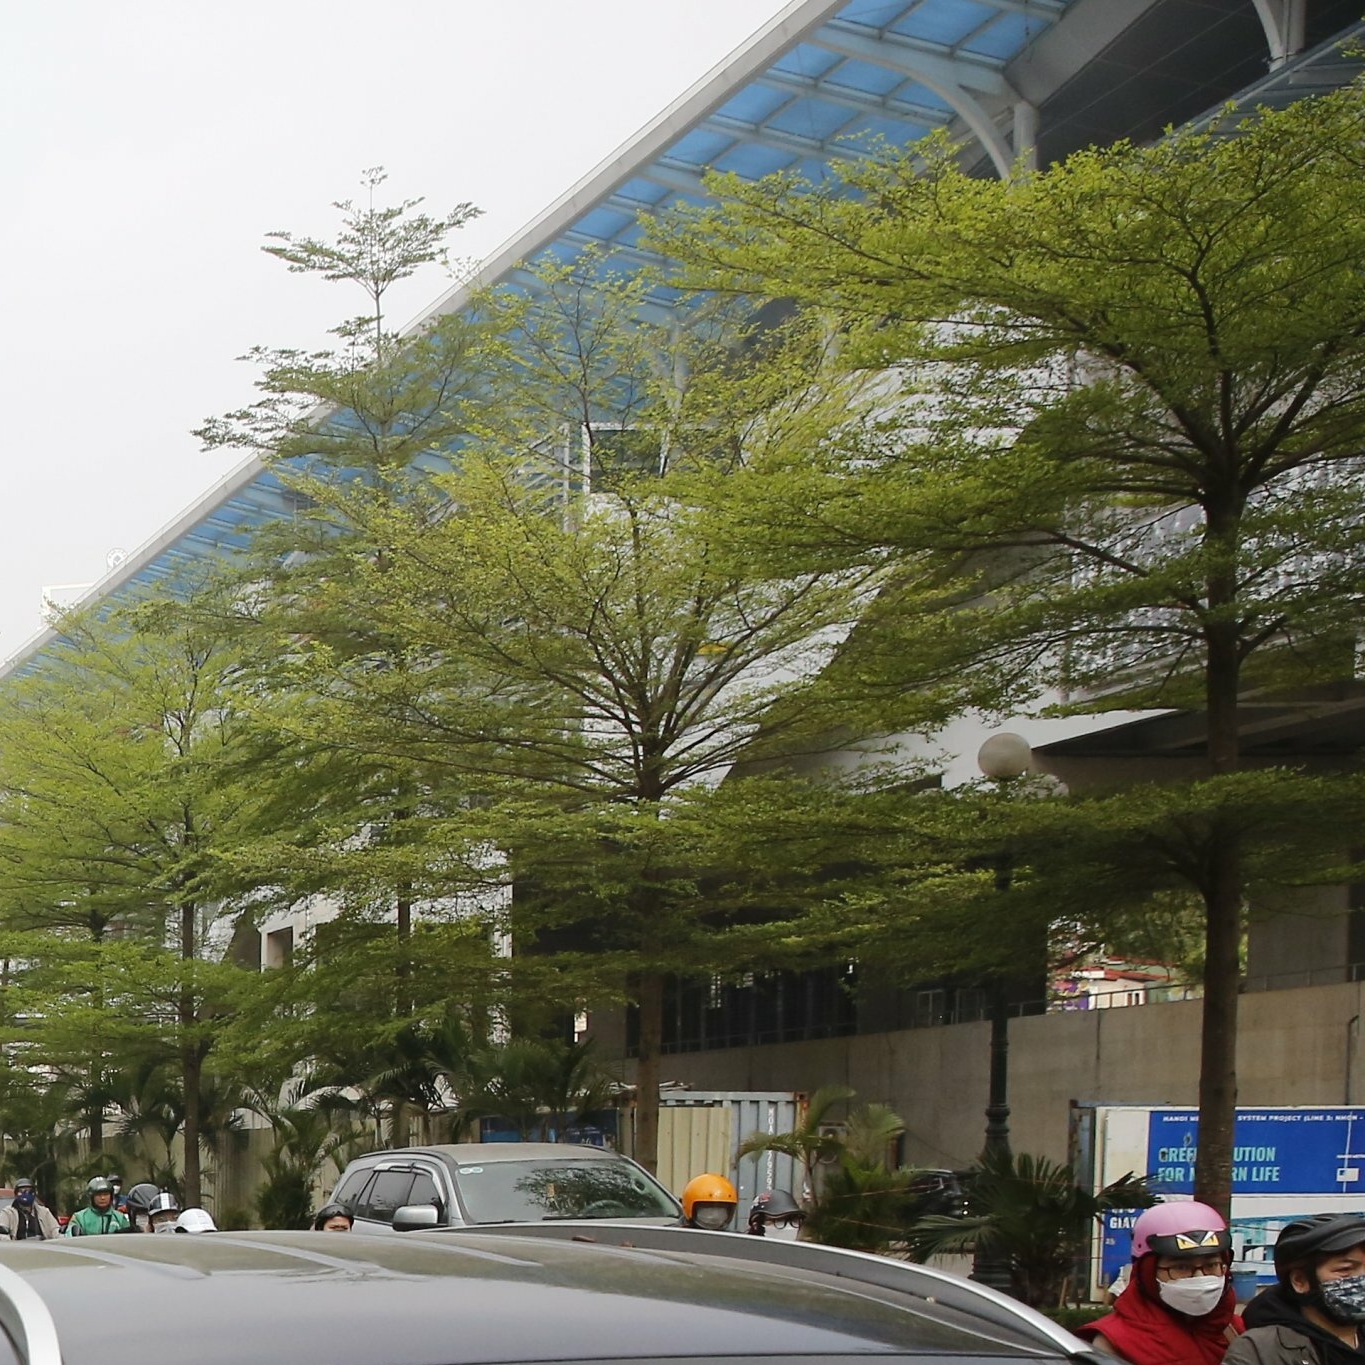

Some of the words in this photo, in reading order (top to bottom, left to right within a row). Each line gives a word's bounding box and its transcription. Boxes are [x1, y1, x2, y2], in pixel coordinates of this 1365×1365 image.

[1233, 1147, 1276, 1162] UTION
[1158, 1167, 1184, 1182] FOR
[1252, 1167, 1280, 1182] LIFE
